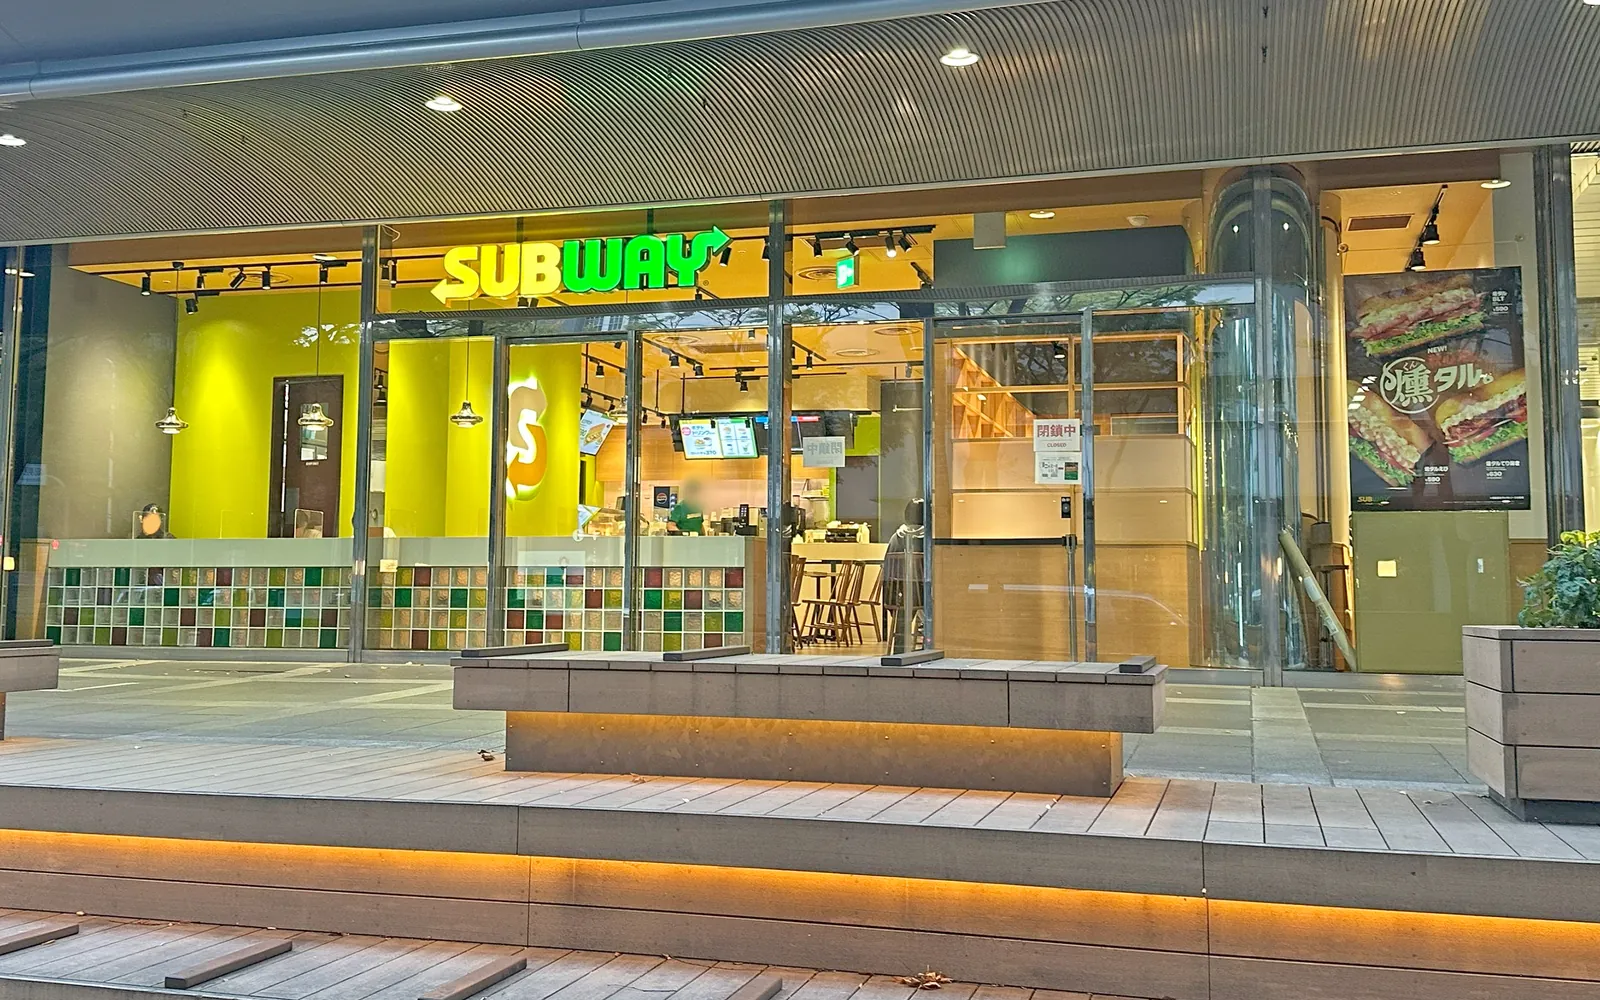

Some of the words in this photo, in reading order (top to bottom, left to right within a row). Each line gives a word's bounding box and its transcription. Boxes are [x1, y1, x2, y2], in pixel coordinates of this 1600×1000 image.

[430, 225, 731, 304] SUBWAY
[1427, 345, 1448, 354] NEW!
[1037, 424, 1076, 438] 閉鎖中
